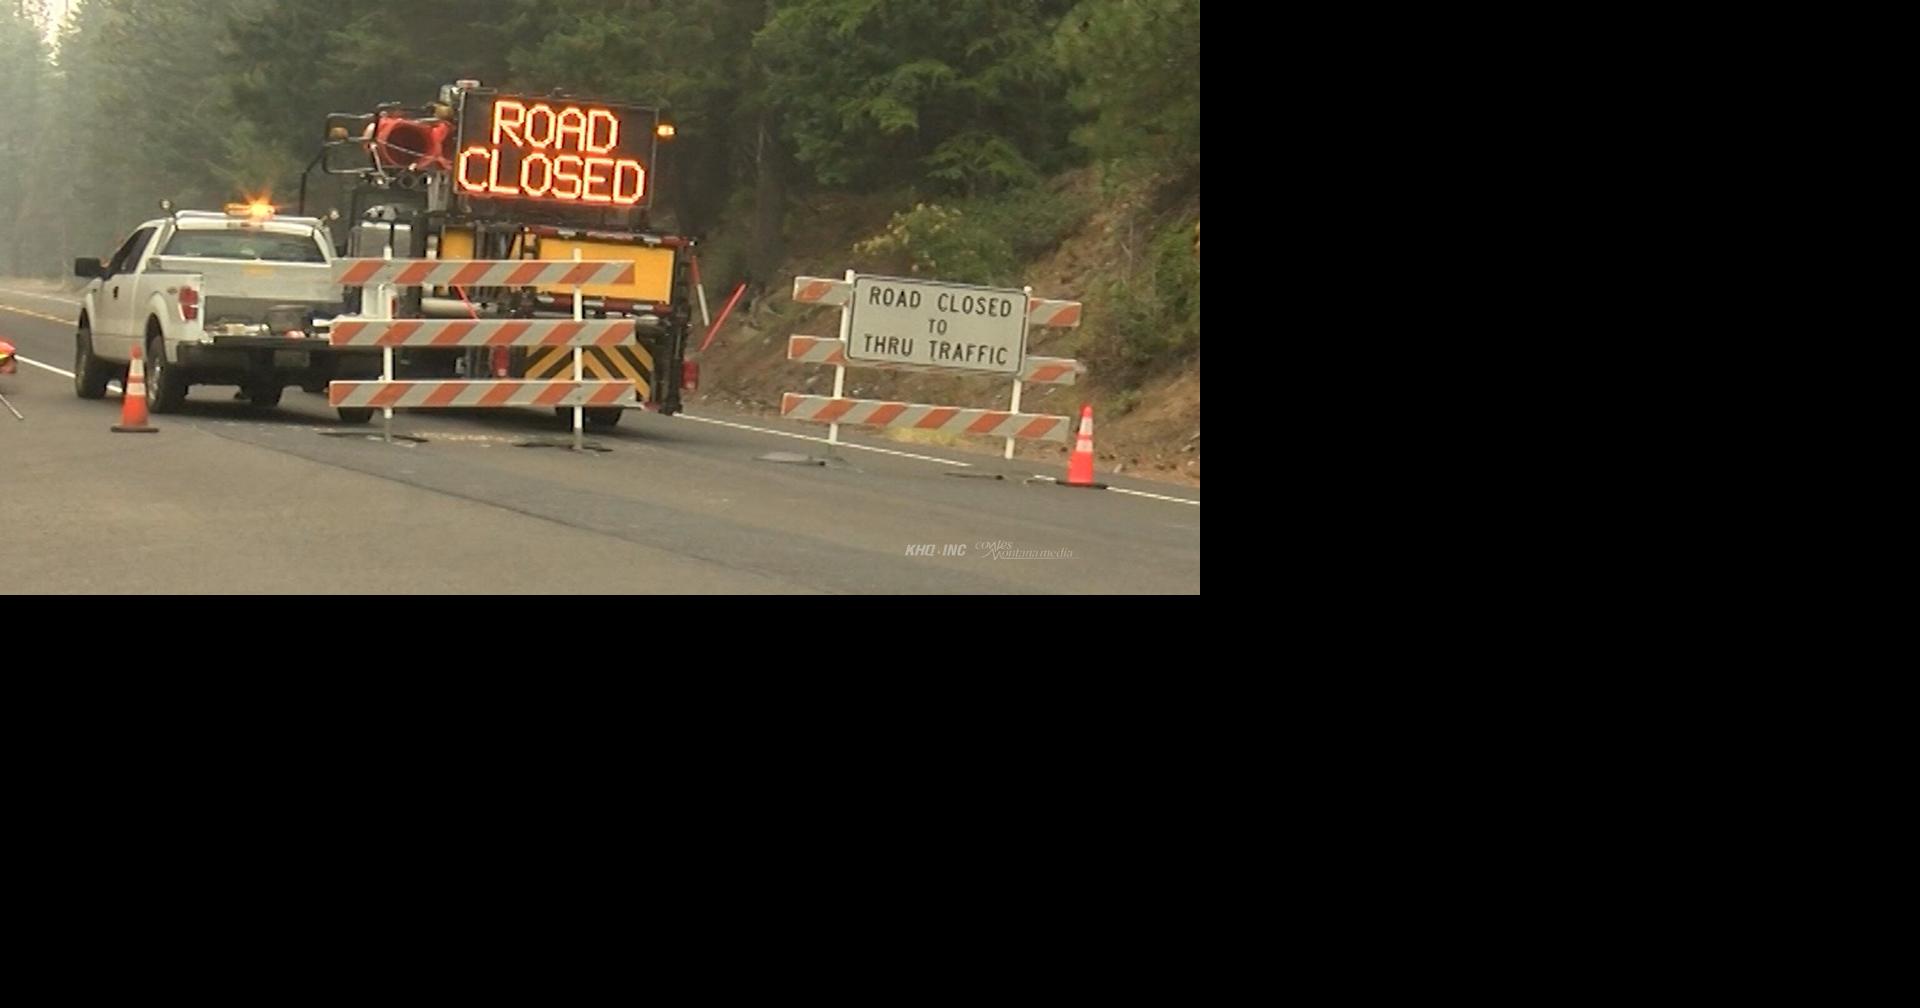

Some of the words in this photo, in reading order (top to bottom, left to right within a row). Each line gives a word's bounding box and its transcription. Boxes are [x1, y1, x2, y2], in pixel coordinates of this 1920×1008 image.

[491, 99, 619, 155] ROAD
[457, 145, 646, 205] CLOSED
[868, 285, 922, 309] ROAD
[937, 292, 1013, 318] CLOSED
[928, 318, 948, 336] TO
[864, 333, 914, 358] THRU
[928, 340, 1009, 366] TRAFFIC
